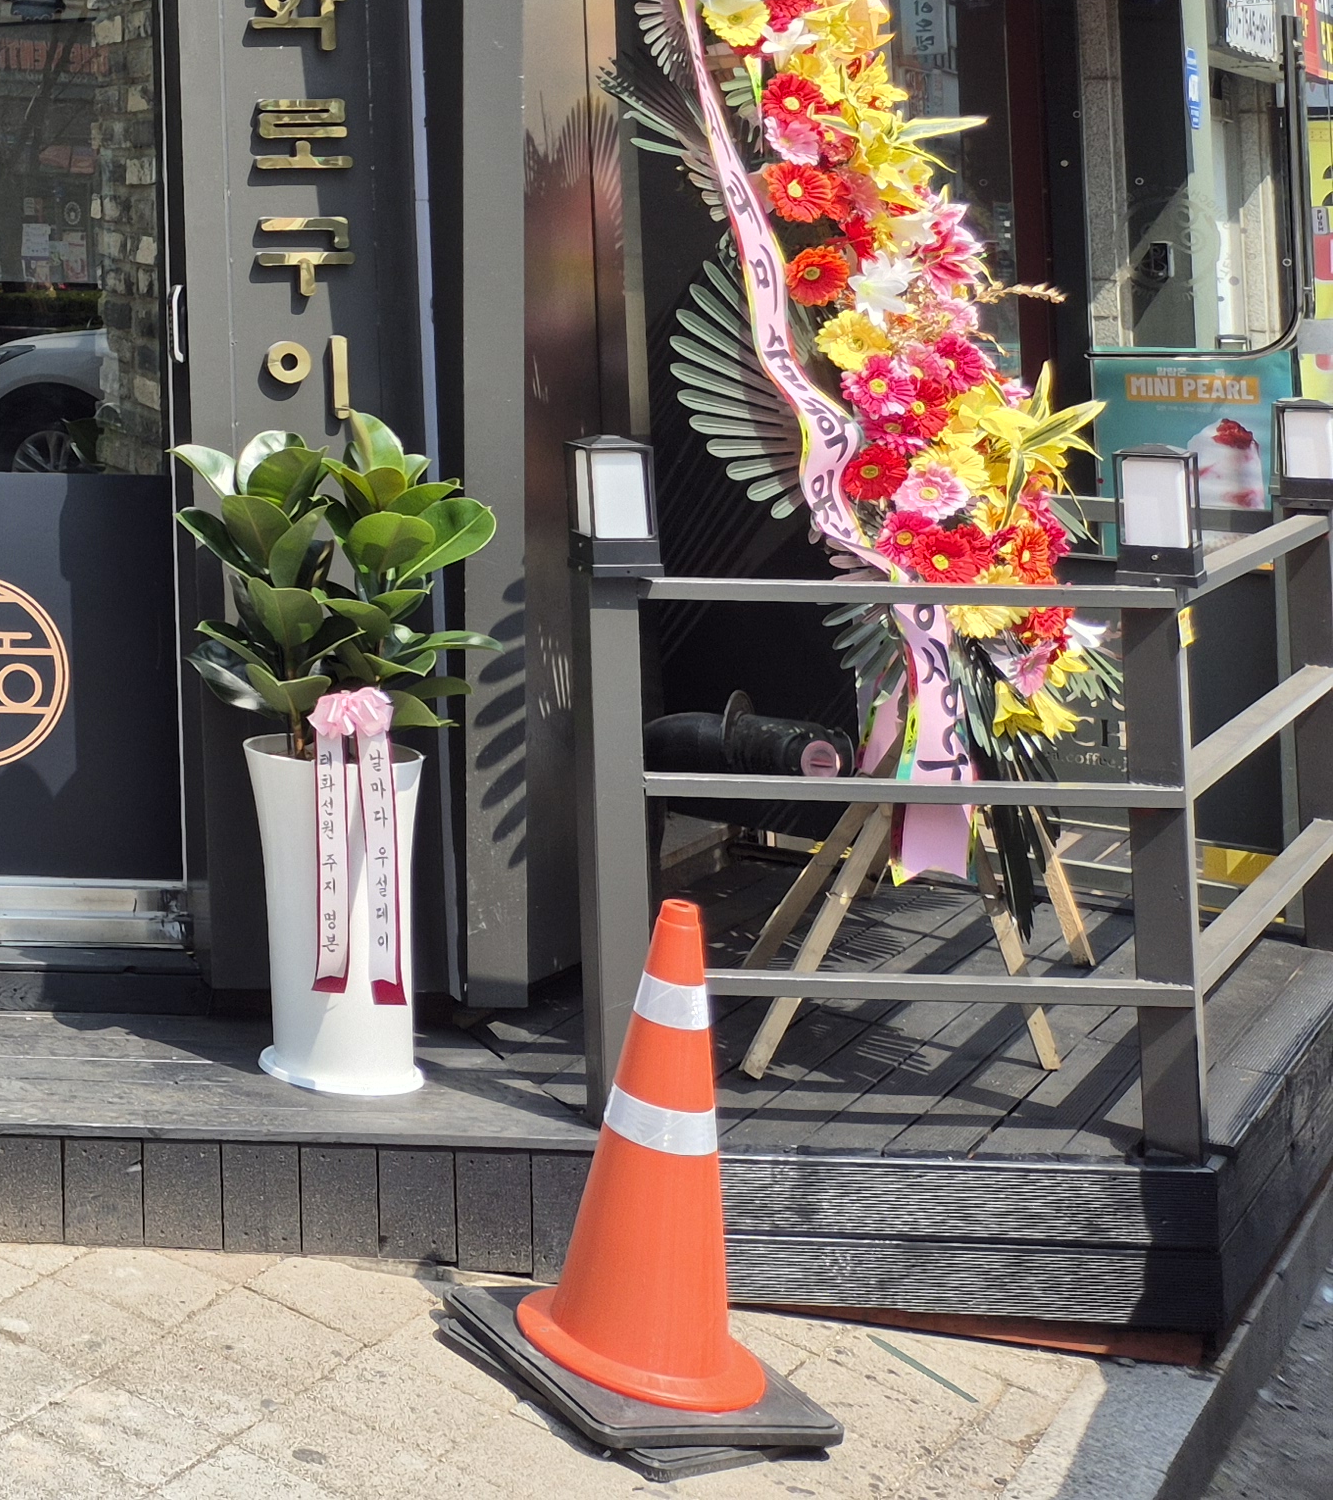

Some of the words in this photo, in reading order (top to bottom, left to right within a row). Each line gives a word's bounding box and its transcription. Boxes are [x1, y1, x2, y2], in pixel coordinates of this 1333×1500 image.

[1130, 376, 1177, 397] MINI
[1183, 378, 1255, 401] PEARL
[368, 748, 389, 829] 날마다
